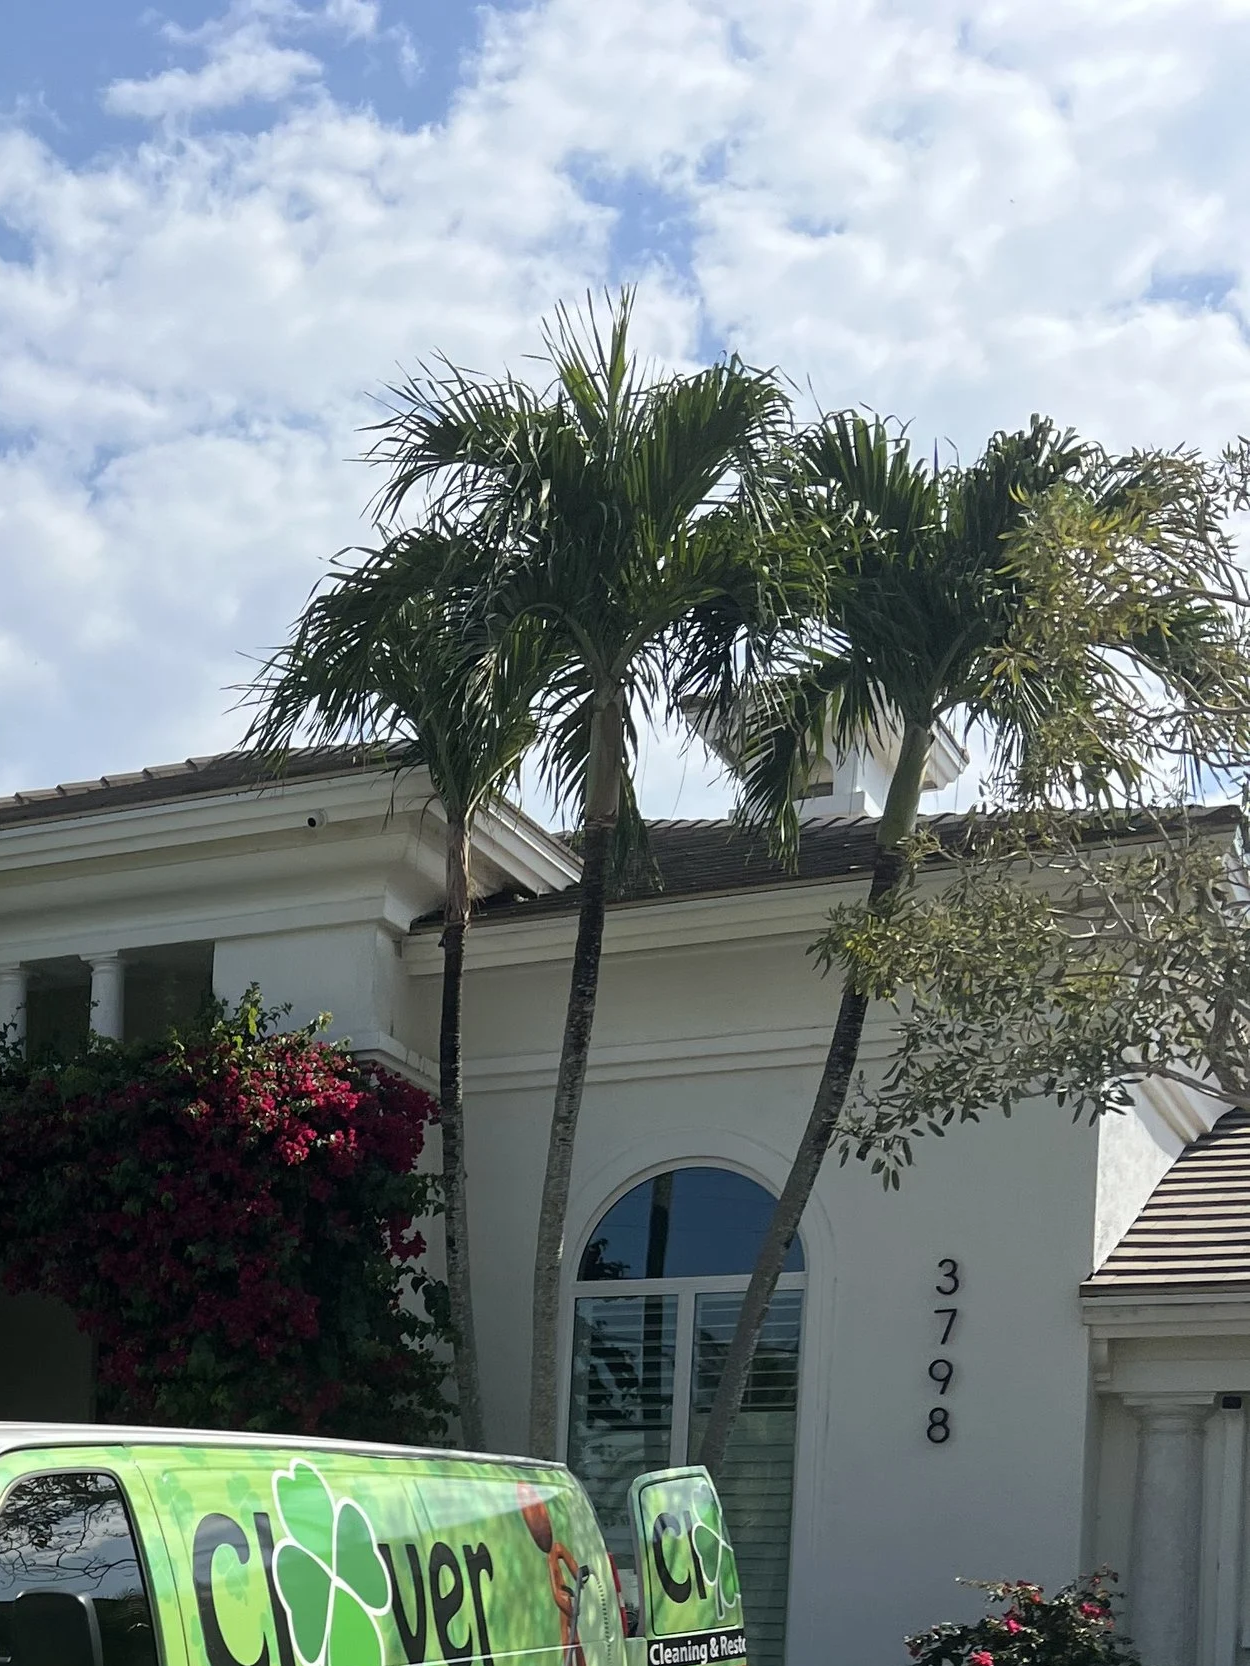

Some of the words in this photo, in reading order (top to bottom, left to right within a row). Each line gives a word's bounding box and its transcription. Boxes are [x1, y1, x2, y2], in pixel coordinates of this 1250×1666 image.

[926, 1258, 960, 1444] 3798
[650, 1640, 708, 1665] Cleaning
[710, 1637, 719, 1658] &
